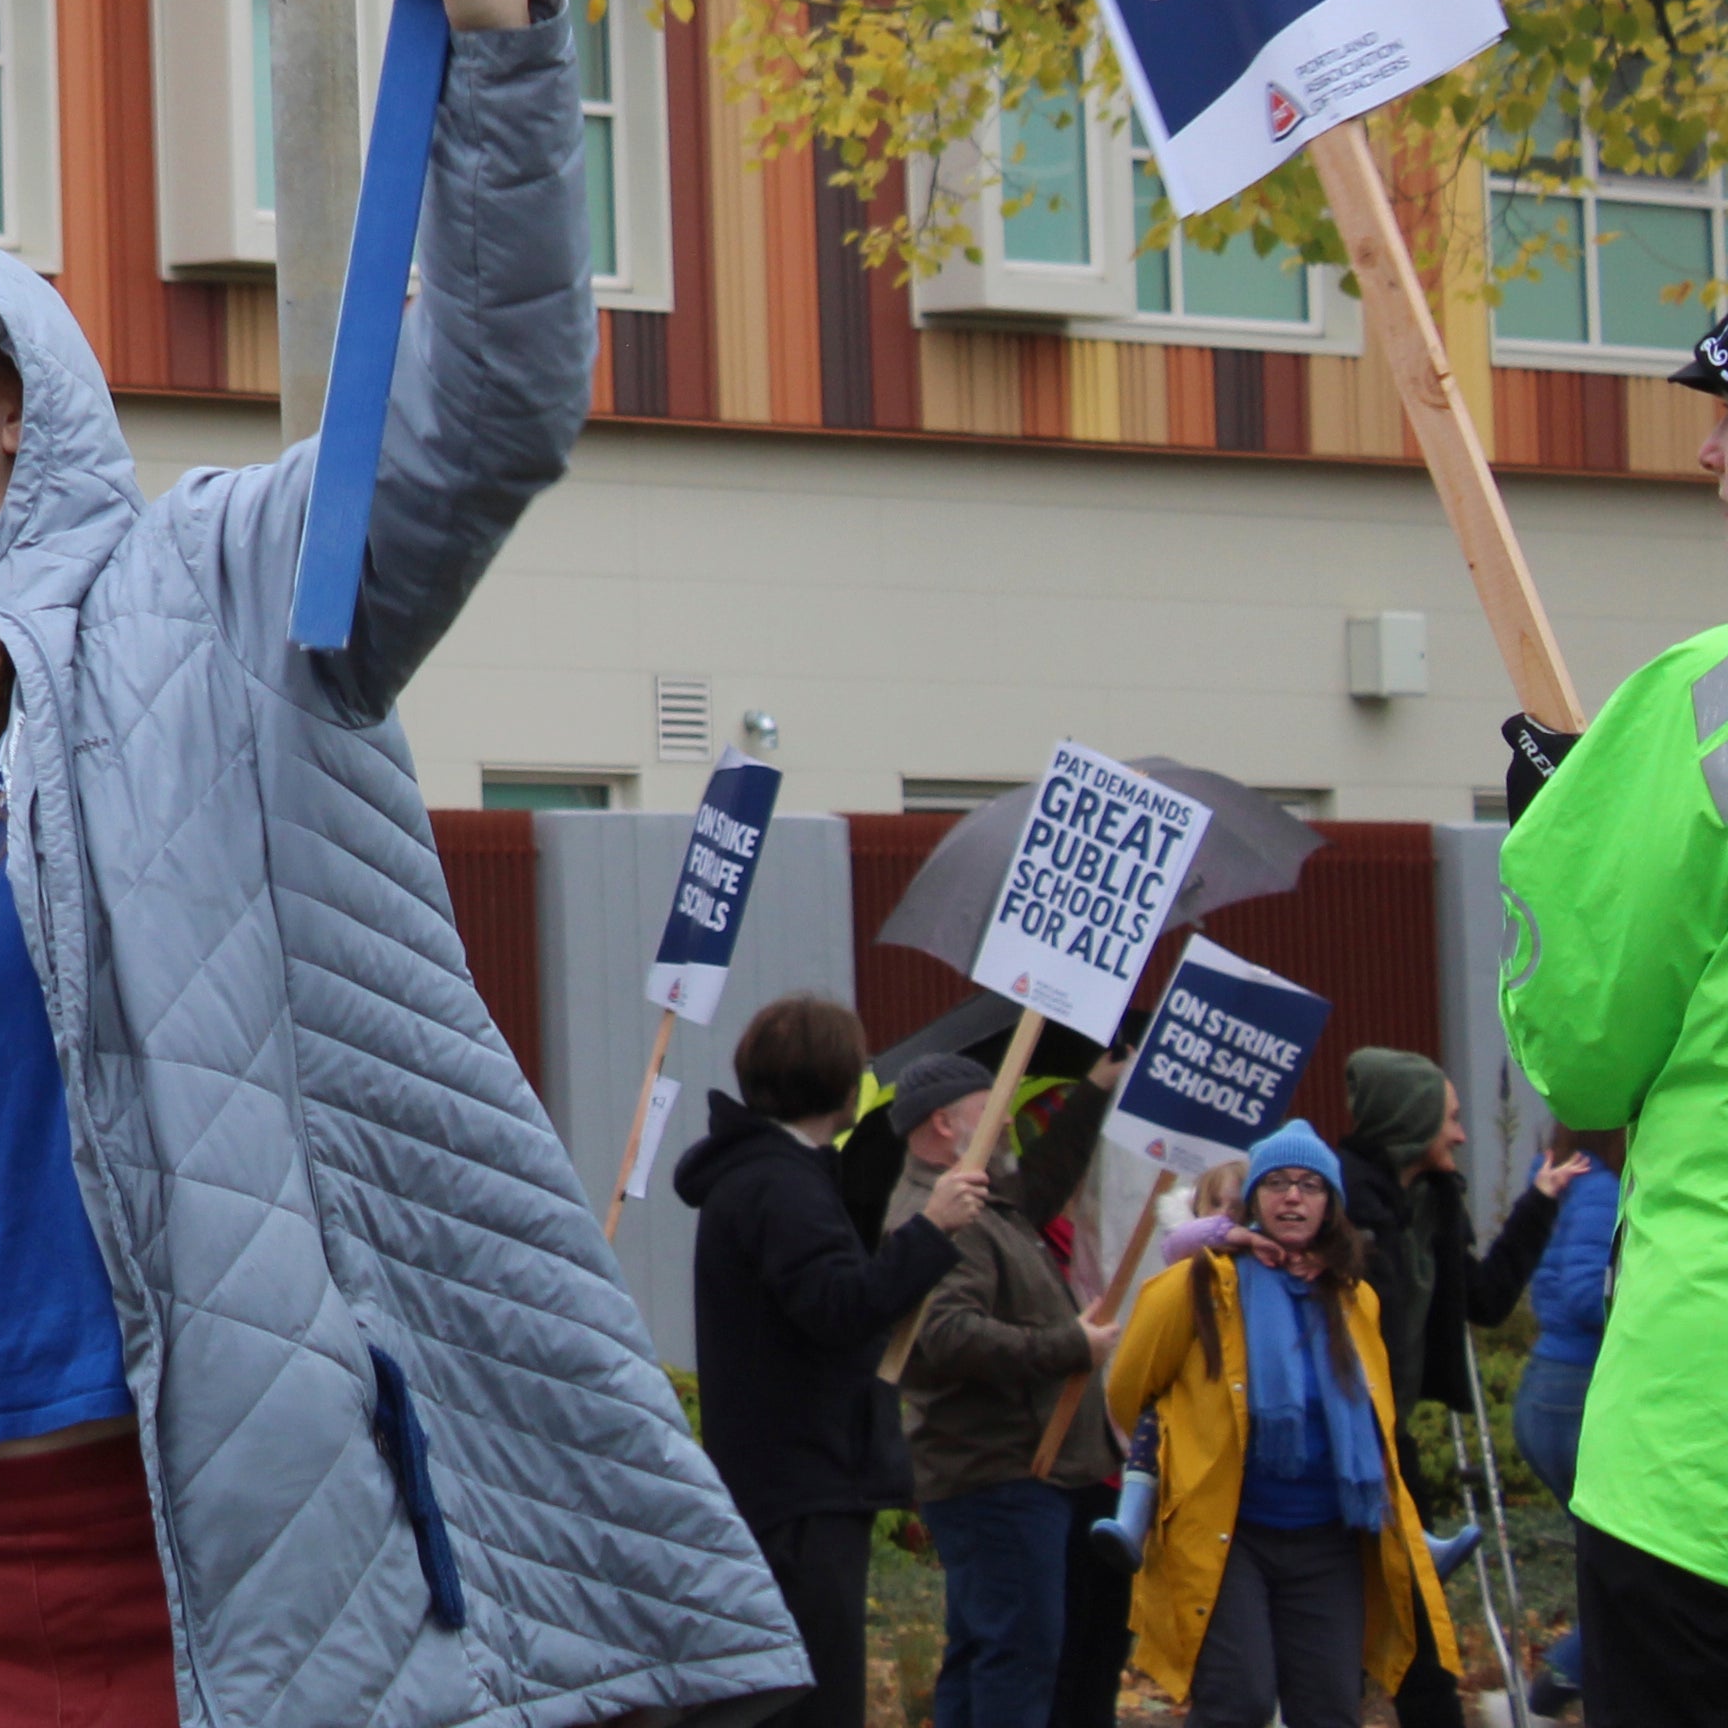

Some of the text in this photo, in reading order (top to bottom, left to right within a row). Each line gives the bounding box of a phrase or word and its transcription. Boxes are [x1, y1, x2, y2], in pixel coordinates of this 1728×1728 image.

[1040, 775, 1184, 869] GREAT
[1054, 749, 1193, 827] PAT DEMANDS
[1013, 859, 1150, 944] SCHOOLS
[1023, 818, 1164, 912] PUBLIC
[999, 889, 1129, 981] FOR ALL
[1160, 1020, 1282, 1099] FOR SAFE
[1168, 988, 1302, 1072] ON STRIKE
[1148, 1052, 1266, 1126] SCHOOLS
